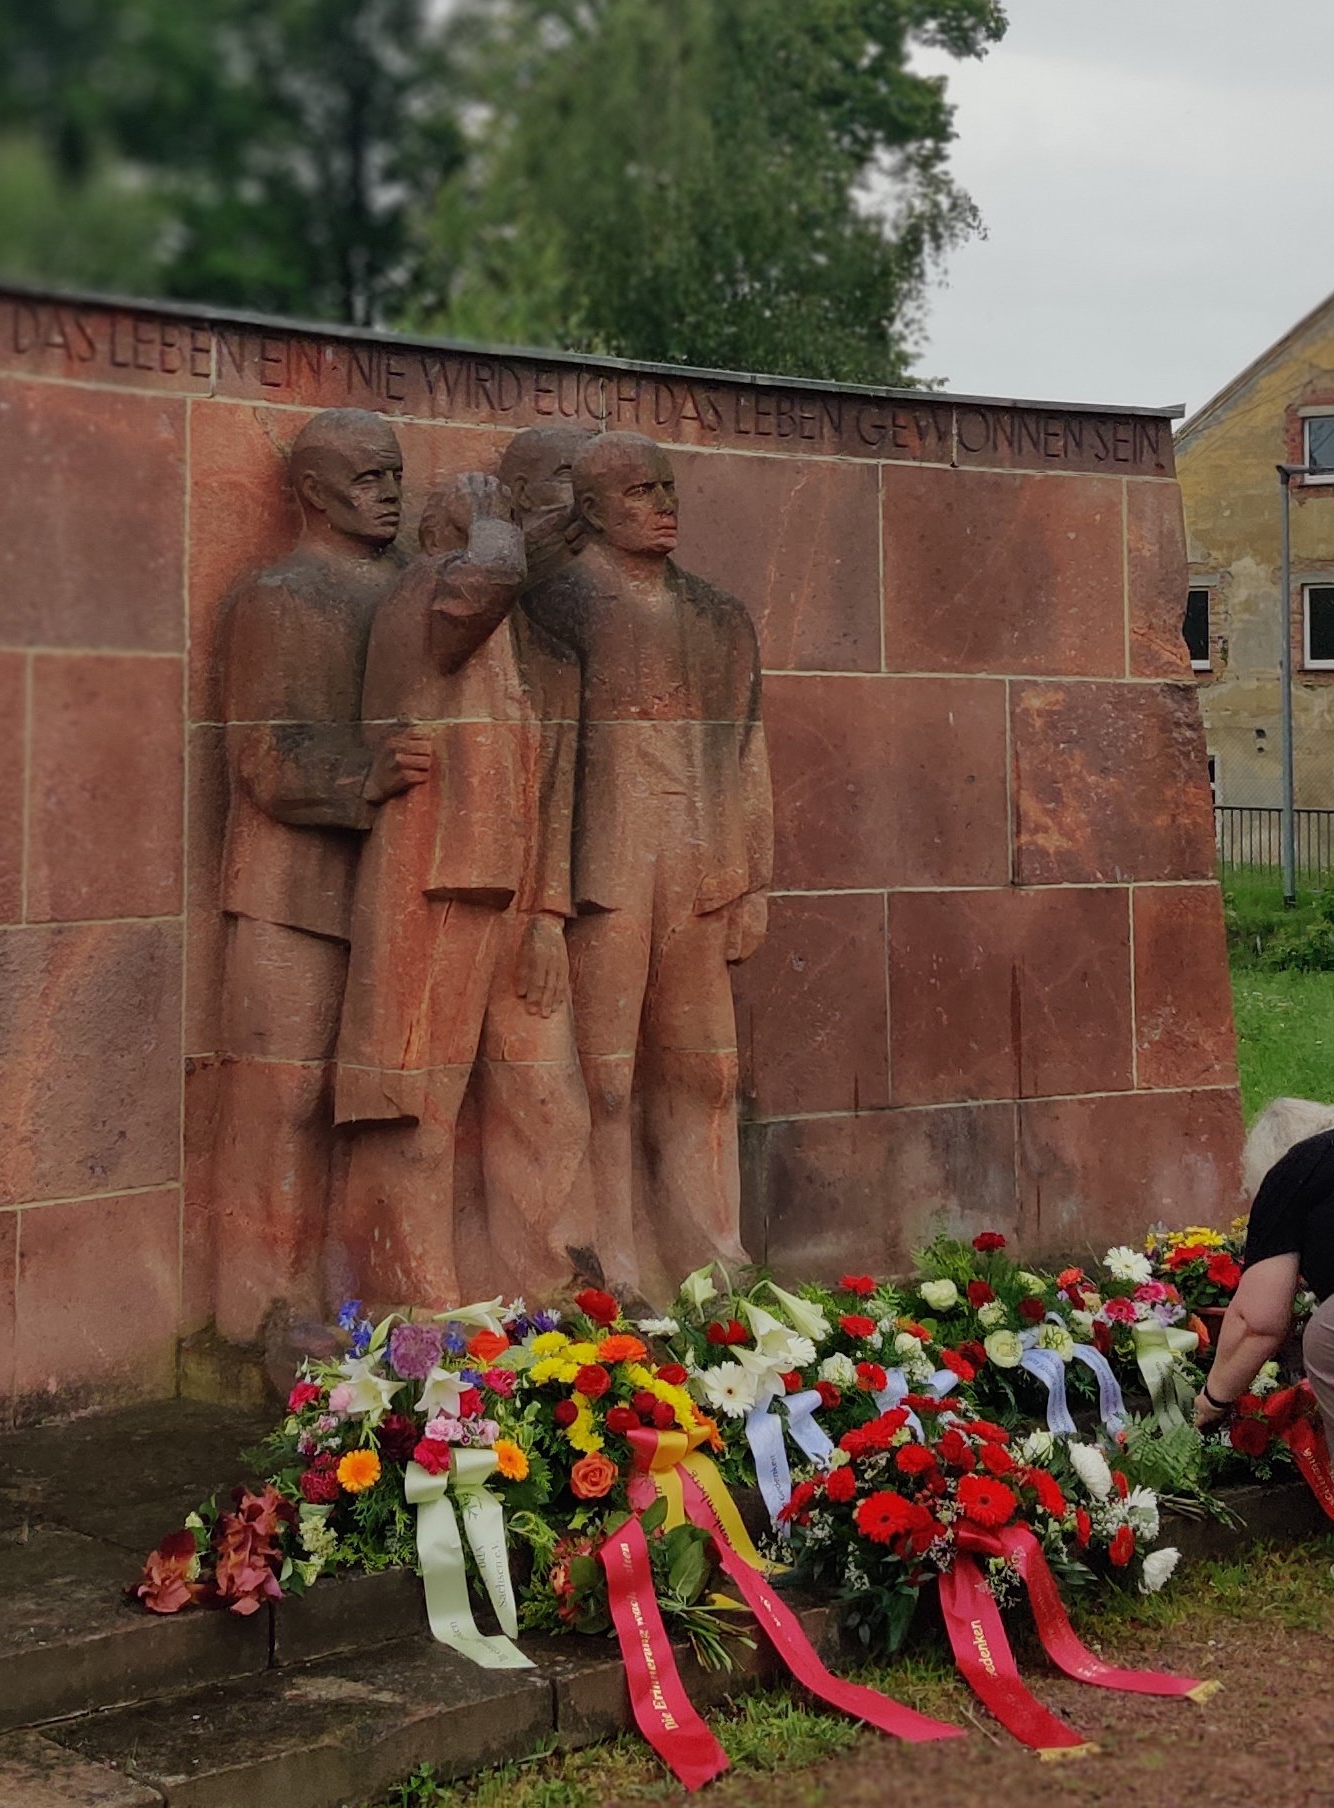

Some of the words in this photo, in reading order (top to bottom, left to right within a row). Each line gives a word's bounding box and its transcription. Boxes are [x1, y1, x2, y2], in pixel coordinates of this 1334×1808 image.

[10, 297, 97, 363] DAS
[109, 306, 245, 383] LEBEN
[345, 344, 407, 402] NIE
[416, 348, 523, 416] WIRD
[533, 360, 643, 426] EUCH
[652, 376, 723, 433] DAS
[733, 387, 845, 444] LEBEN
[855, 400, 1087, 460] GEWONNEN
[493, 1560, 509, 1608] Sachsen
[638, 1629, 666, 1710] Erinnerung
[661, 1712, 679, 1731] Die
